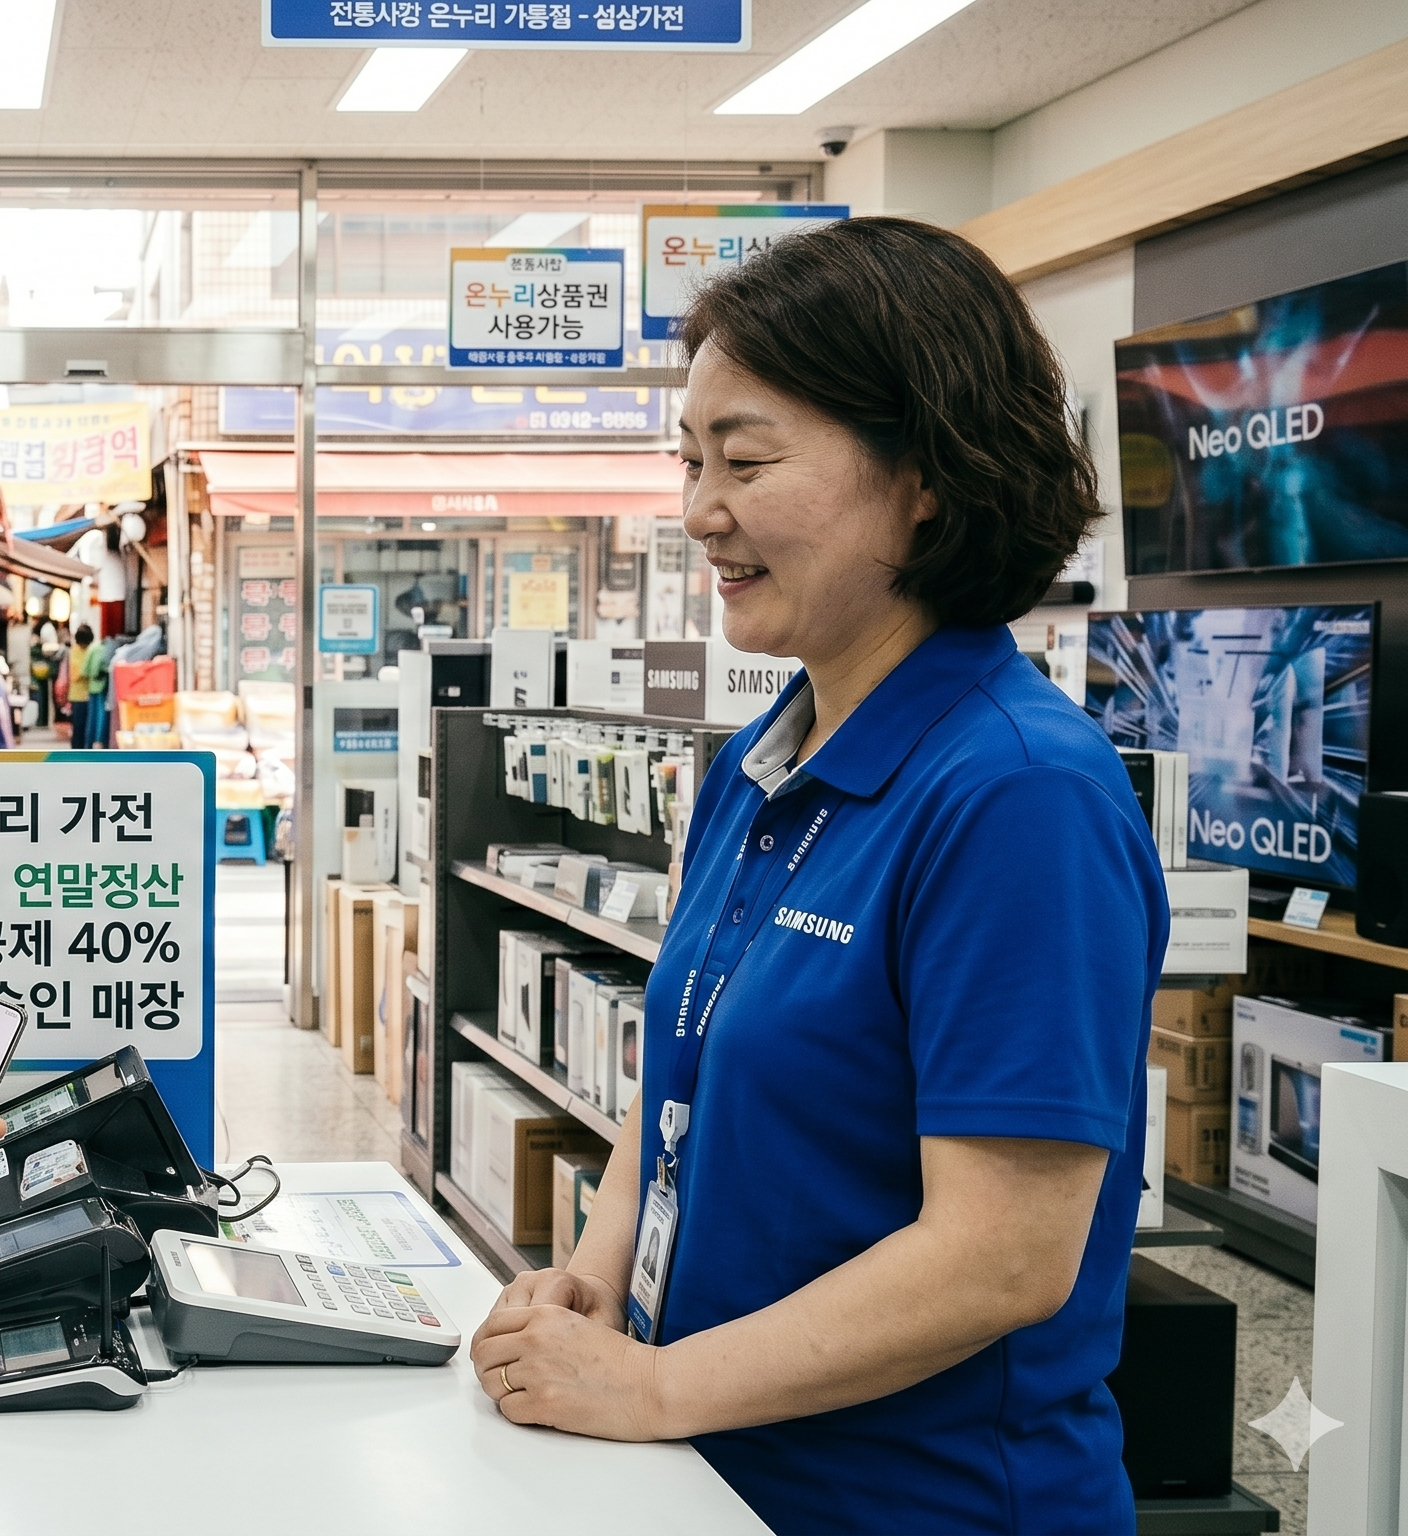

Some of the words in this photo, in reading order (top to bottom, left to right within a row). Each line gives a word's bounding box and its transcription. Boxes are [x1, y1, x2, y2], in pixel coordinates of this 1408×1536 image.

[465, 282, 608, 308] 온누리상품권
[488, 314, 584, 340] 사용가능
[1188, 424, 1242, 461] Neo
[1246, 402, 1325, 450] QLED
[647, 668, 700, 691] SAMSUNG
[728, 668, 795, 695] SAMSU
[60, 791, 154, 843] 가전
[1189, 807, 1246, 851] Neo
[1250, 816, 1332, 864] QLED
[13, 861, 185, 910] 연말정산
[67, 920, 182, 965] 40%
[774, 905, 855, 945] SAMSUNG
[92, 980, 185, 1031] 매장
